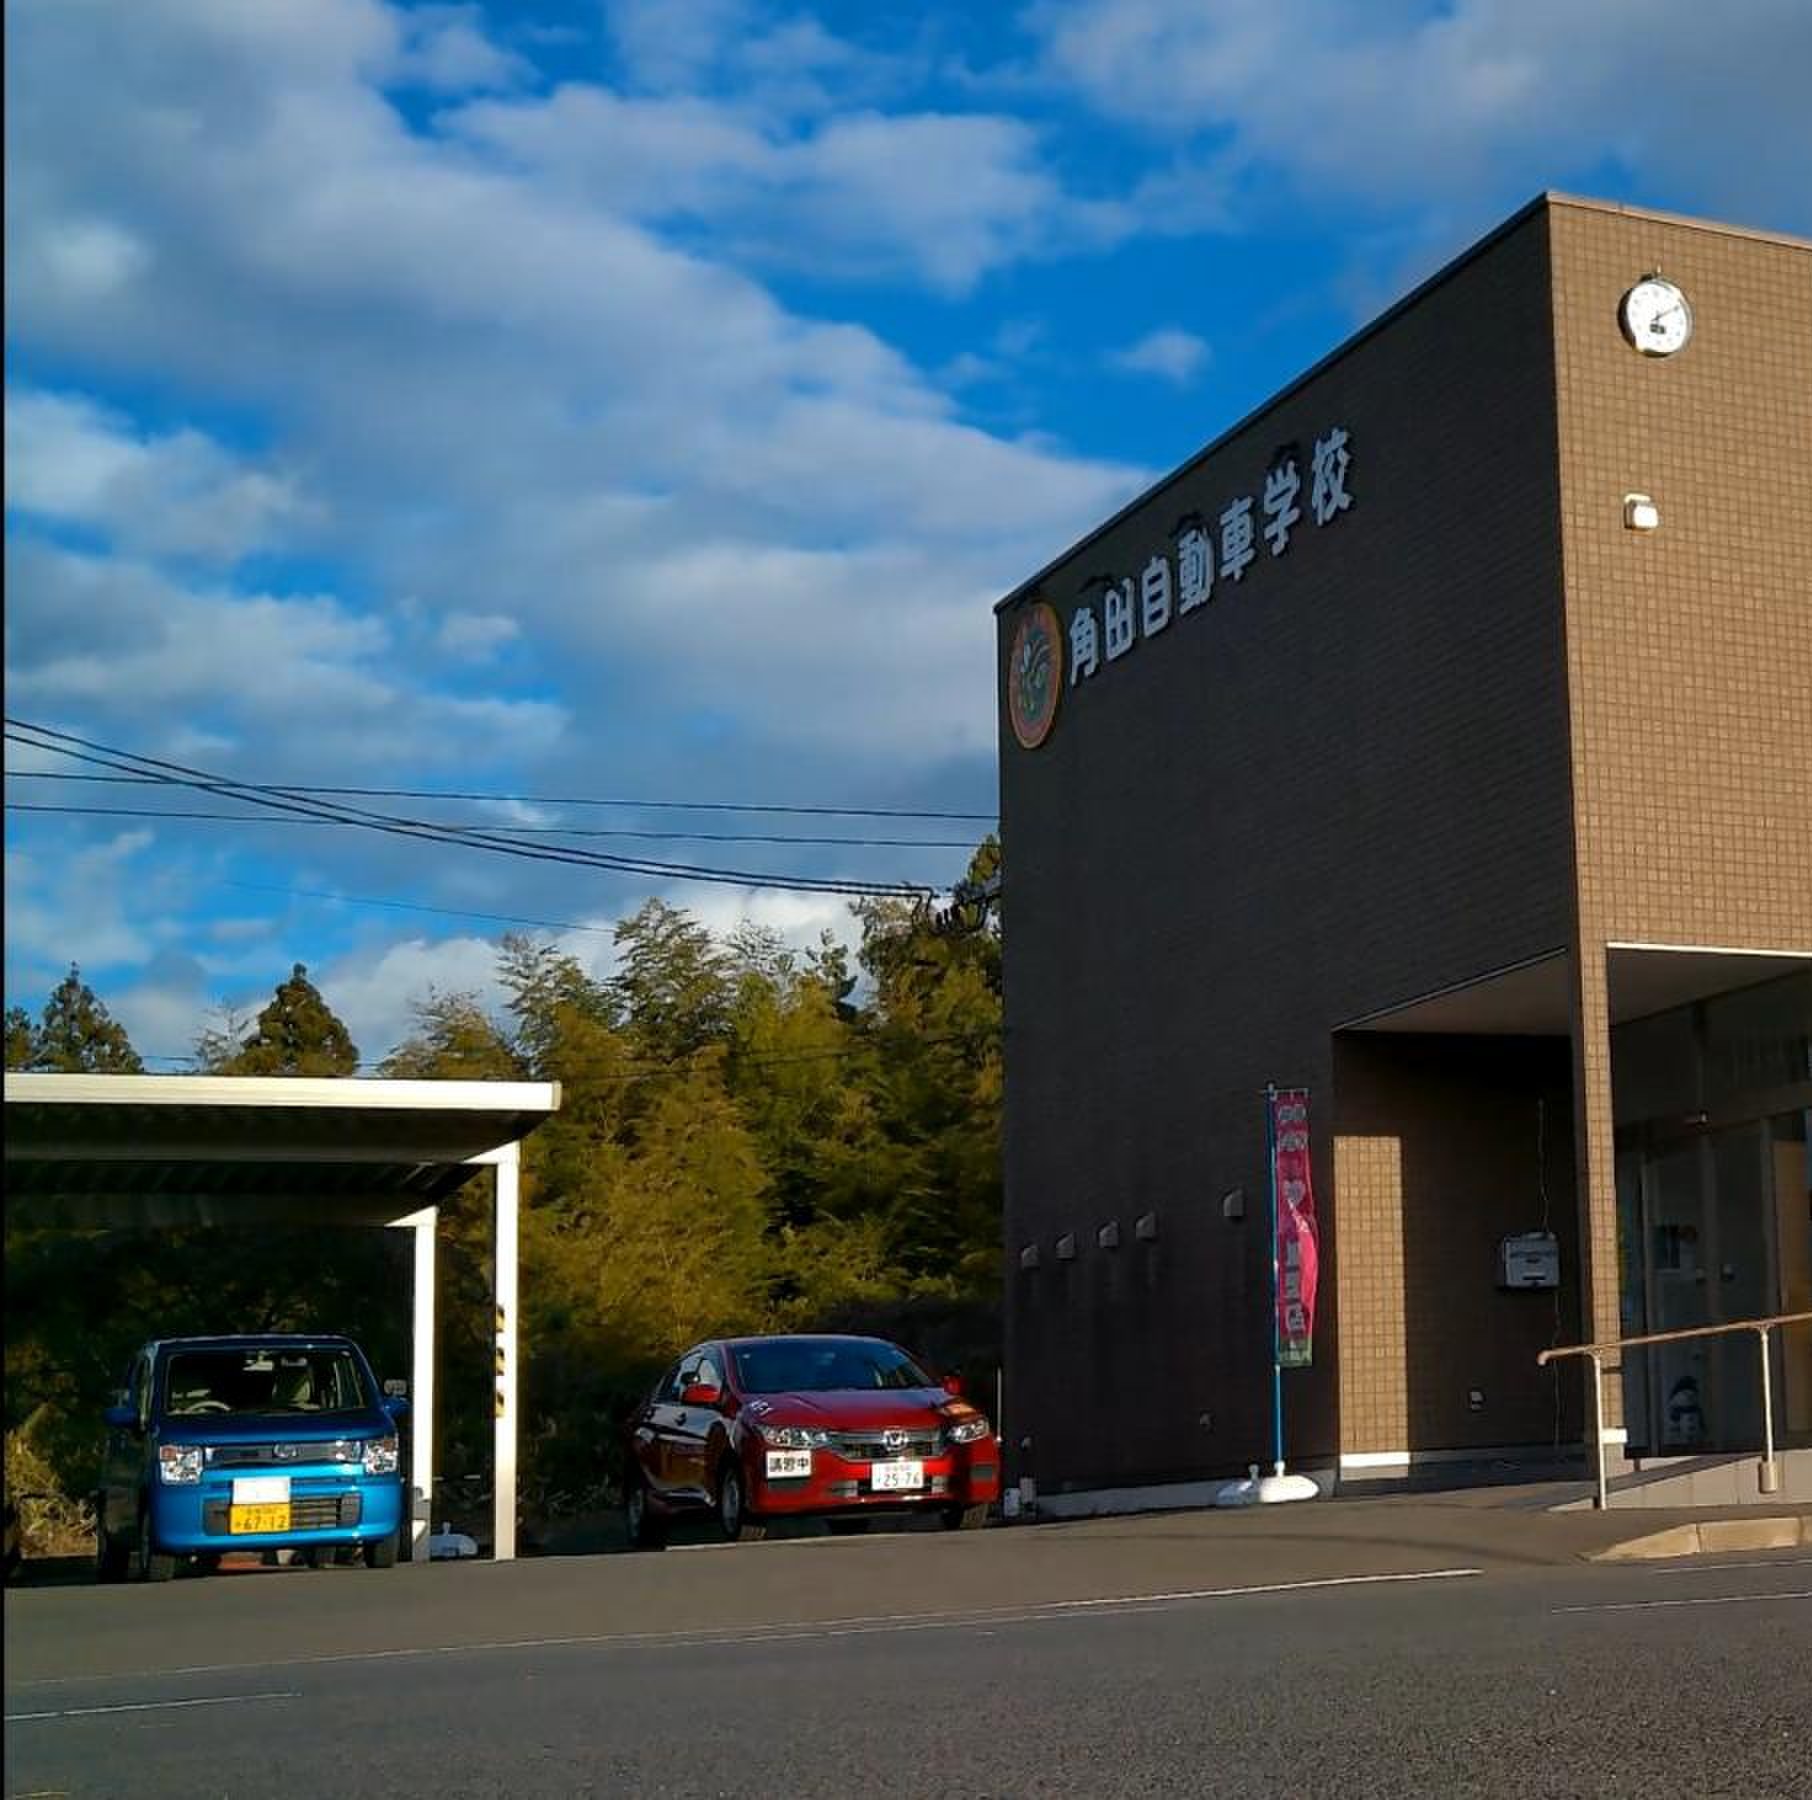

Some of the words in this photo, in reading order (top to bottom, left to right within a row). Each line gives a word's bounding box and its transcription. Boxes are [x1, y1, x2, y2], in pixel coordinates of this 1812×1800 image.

[1070, 427, 1354, 687] 角田自動車学校
